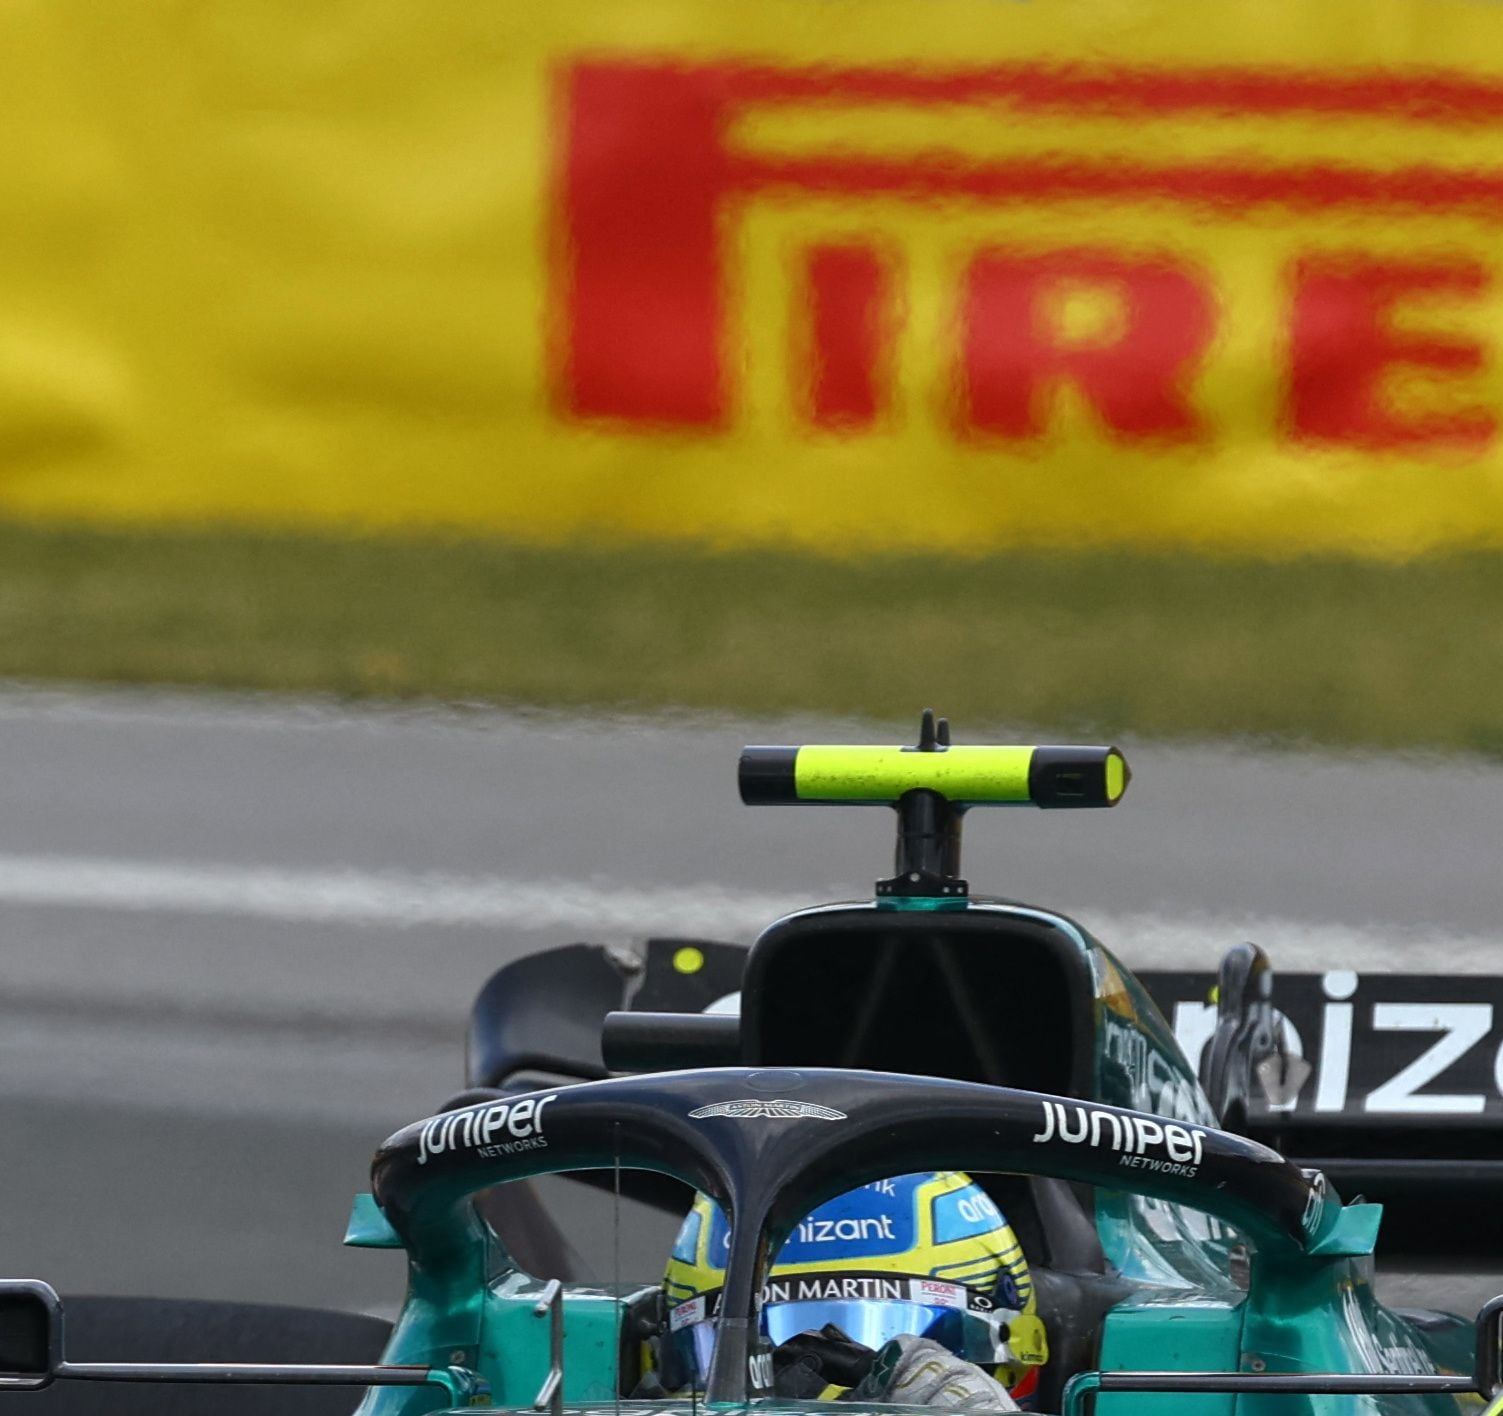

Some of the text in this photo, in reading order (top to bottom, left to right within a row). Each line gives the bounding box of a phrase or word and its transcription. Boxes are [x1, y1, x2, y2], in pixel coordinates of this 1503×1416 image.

[476, 1136, 549, 1160] NETWORKS
[1119, 1155, 1198, 1179] NETWORKS
[798, 1278, 902, 1299] MARTIN
